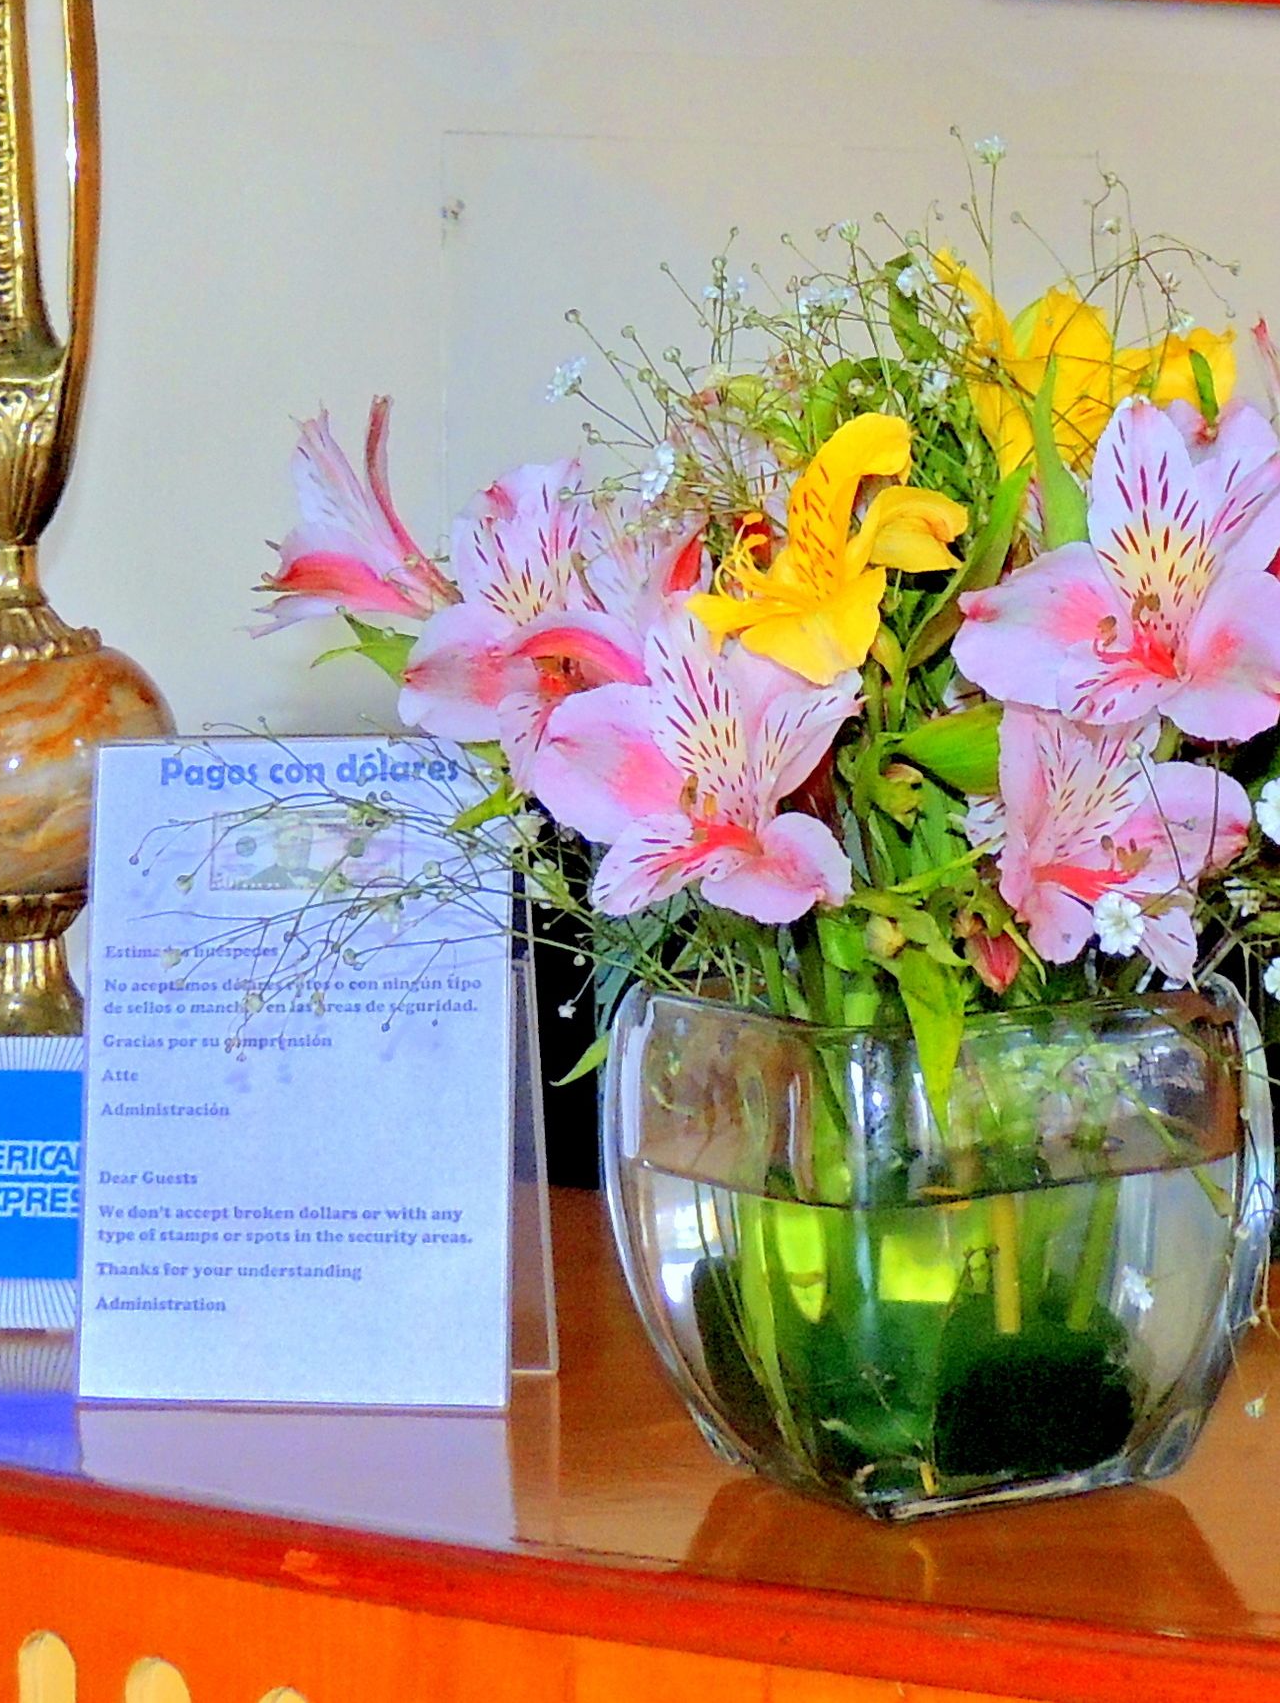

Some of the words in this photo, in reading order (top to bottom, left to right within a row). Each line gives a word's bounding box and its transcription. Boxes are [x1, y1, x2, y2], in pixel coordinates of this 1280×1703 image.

[160, 757, 258, 790] Pagos
[270, 760, 325, 785] con
[336, 753, 459, 783] dólares
[104, 979, 127, 992] No
[334, 981, 344, 990] o
[348, 980, 378, 990] con
[447, 978, 482, 992] tipo
[104, 1001, 122, 1014] de
[127, 1001, 171, 1014] sellos
[176, 1004, 186, 1014] o
[266, 1004, 286, 1014] en
[289, 1000, 312, 1013] las
[319, 1002, 361, 1013] reas
[365, 999, 385, 1013] de
[389, 999, 478, 1015] seguridad.
[103, 1034, 164, 1048] Gracias
[168, 1037, 198, 1049] por
[201, 1037, 220, 1047] su
[102, 1069, 139, 1082] Atte
[100, 1102, 230, 1116] Administración
[99, 1170, 138, 1184] Dear
[142, 1170, 198, 1184] Guests
[99, 1205, 124, 1219] We
[127, 1205, 171, 1219] don't
[175, 1207, 229, 1222] accept
[233, 1206, 295, 1220] broken
[299, 1206, 358, 1220] dollars
[362, 1209, 381, 1220] or
[386, 1207, 427, 1220] with
[431, 1209, 463, 1223] any
[98, 1229, 135, 1244] type
[139, 1228, 156, 1241] of
[160, 1229, 219, 1244] stamps
[223, 1231, 242, 1242] or
[245, 1230, 290, 1244] spots
[294, 1229, 311, 1242] in
[316, 1229, 343, 1243] the
[348, 1230, 417, 1246] security
[422, 1232, 473, 1244] areas.
[96, 1262, 160, 1276] Thanks
[163, 1262, 188, 1276] for
[193, 1265, 233, 1279] your
[237, 1264, 362, 1281] understanding
[96, 1296, 227, 1312] Administration
